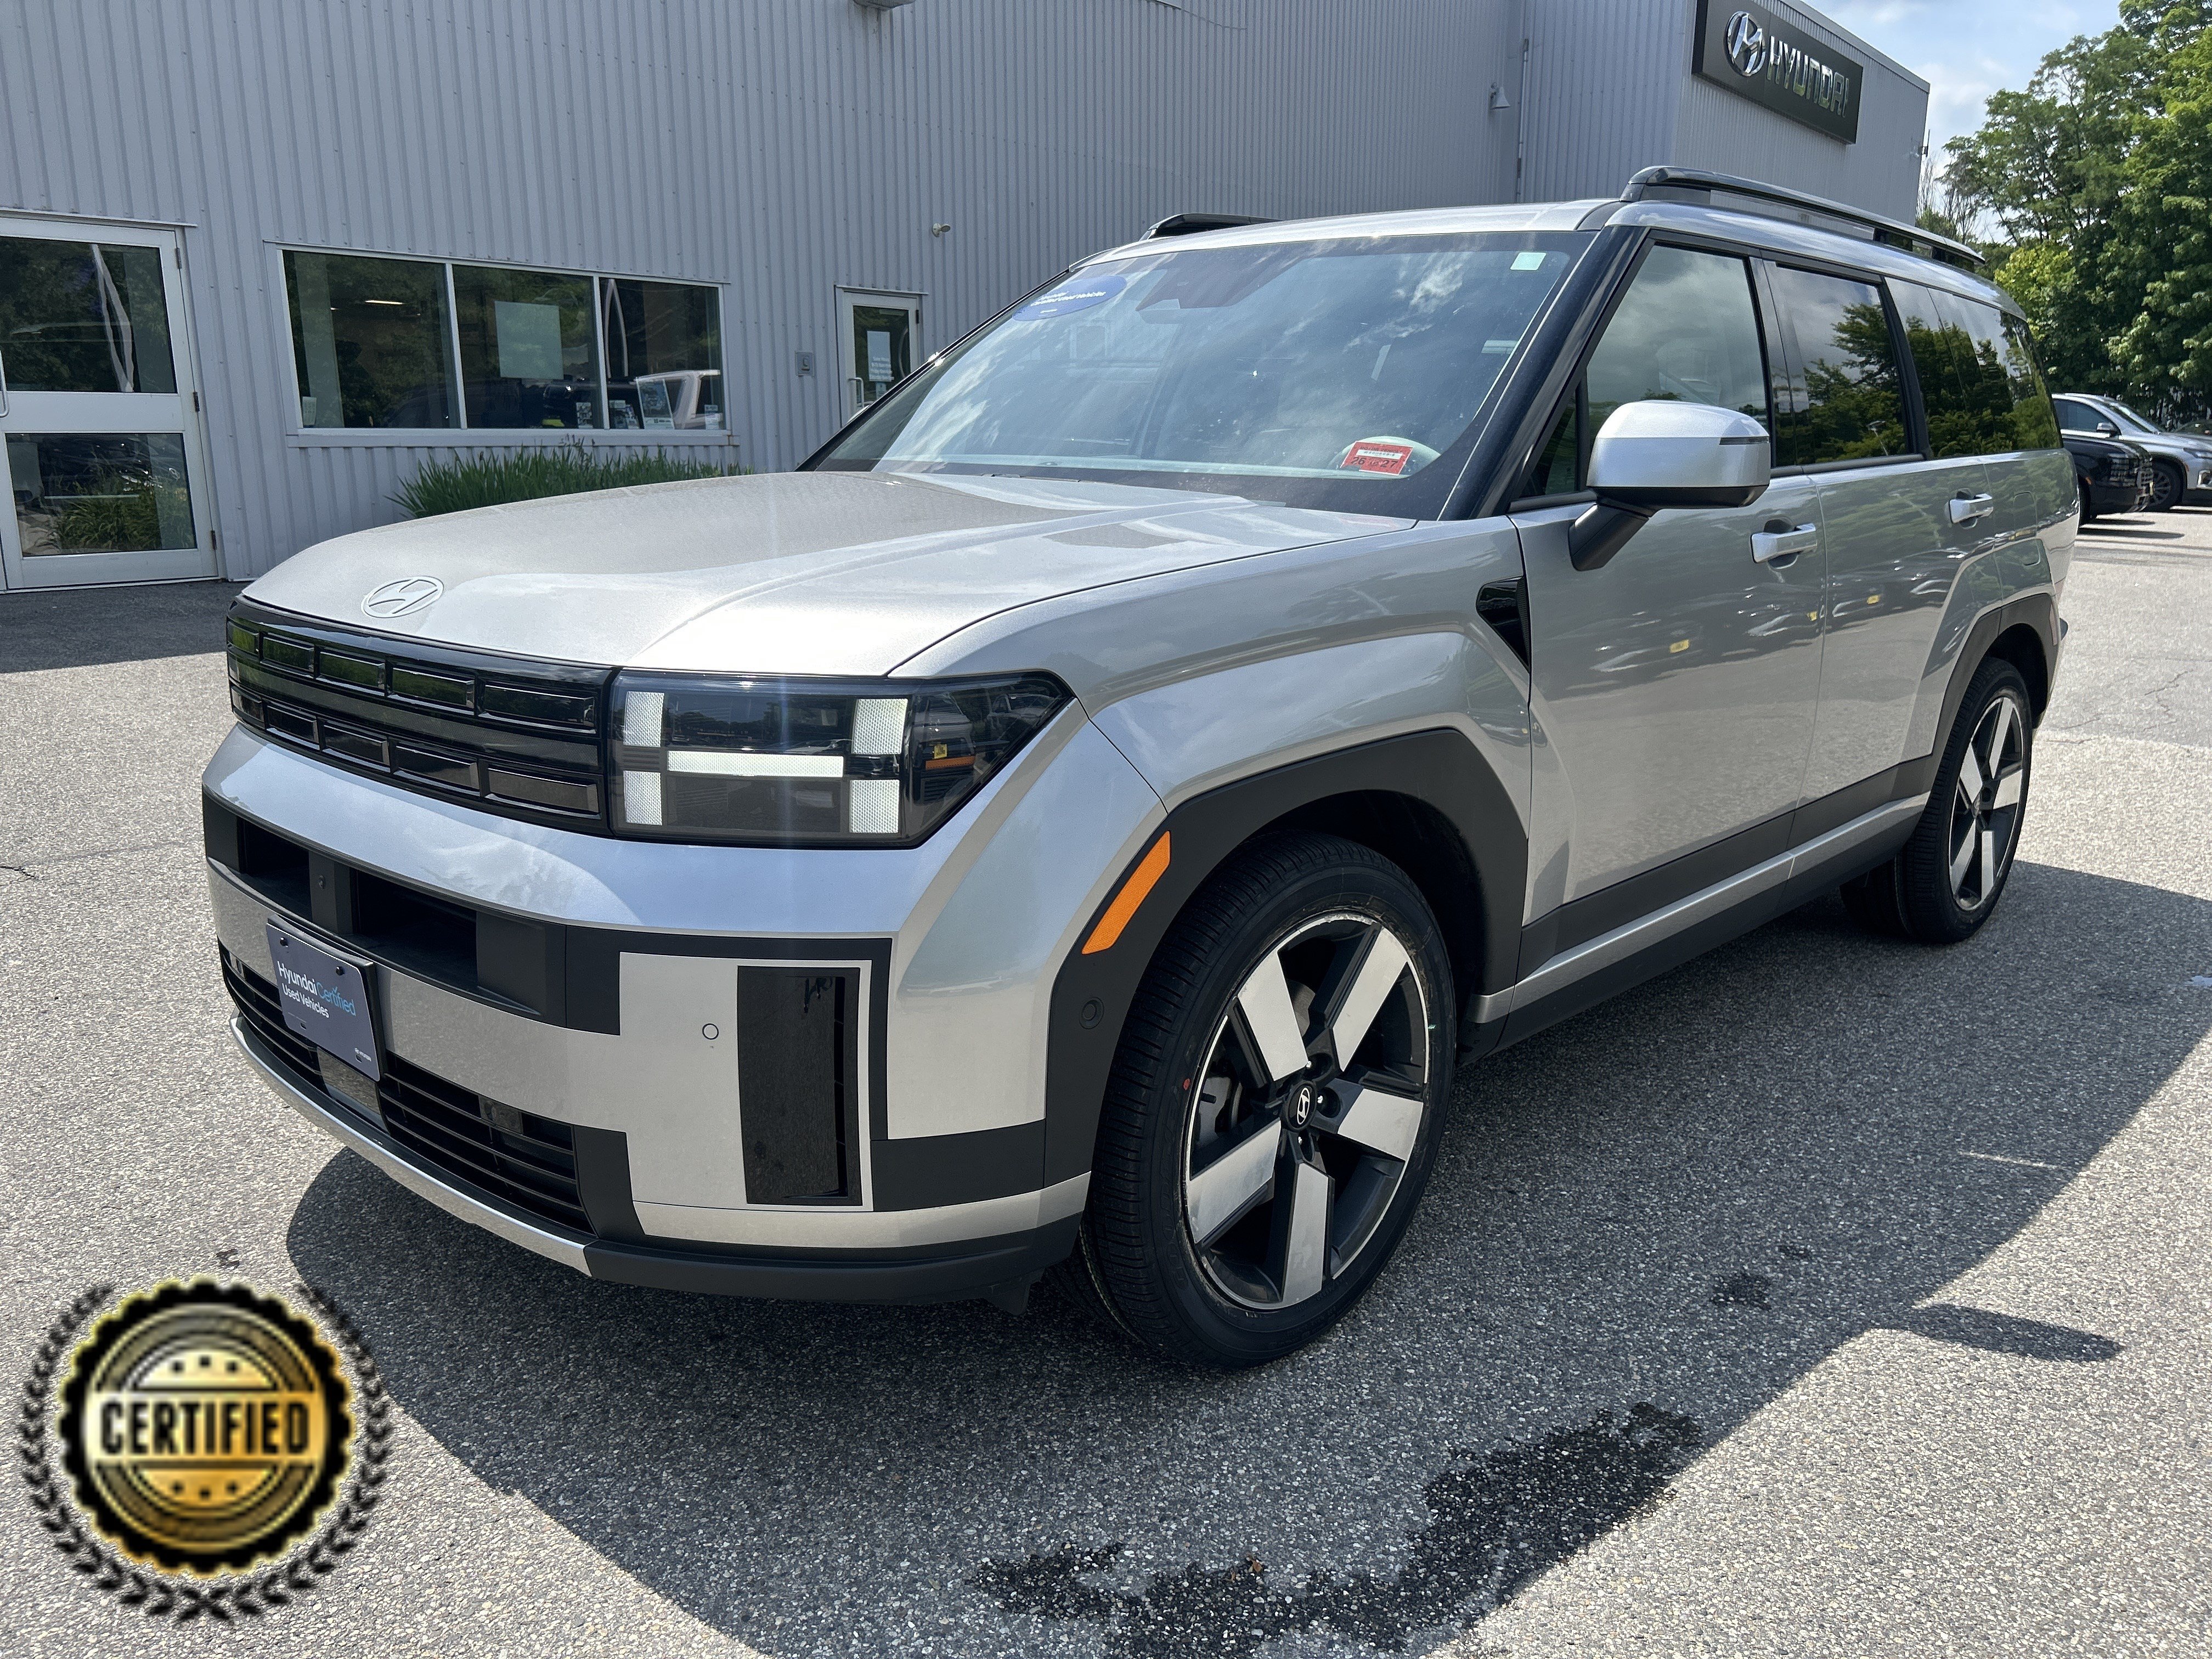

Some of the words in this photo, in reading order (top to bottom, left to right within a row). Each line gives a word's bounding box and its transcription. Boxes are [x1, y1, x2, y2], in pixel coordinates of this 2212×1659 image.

[1766, 36, 1849, 118] HYUNDAI
[1350, 456, 1367, 465] 26
[1380, 460, 1398, 468] 27
[282, 983, 300, 1002] Used
[300, 992, 329, 1018] Vehicles
